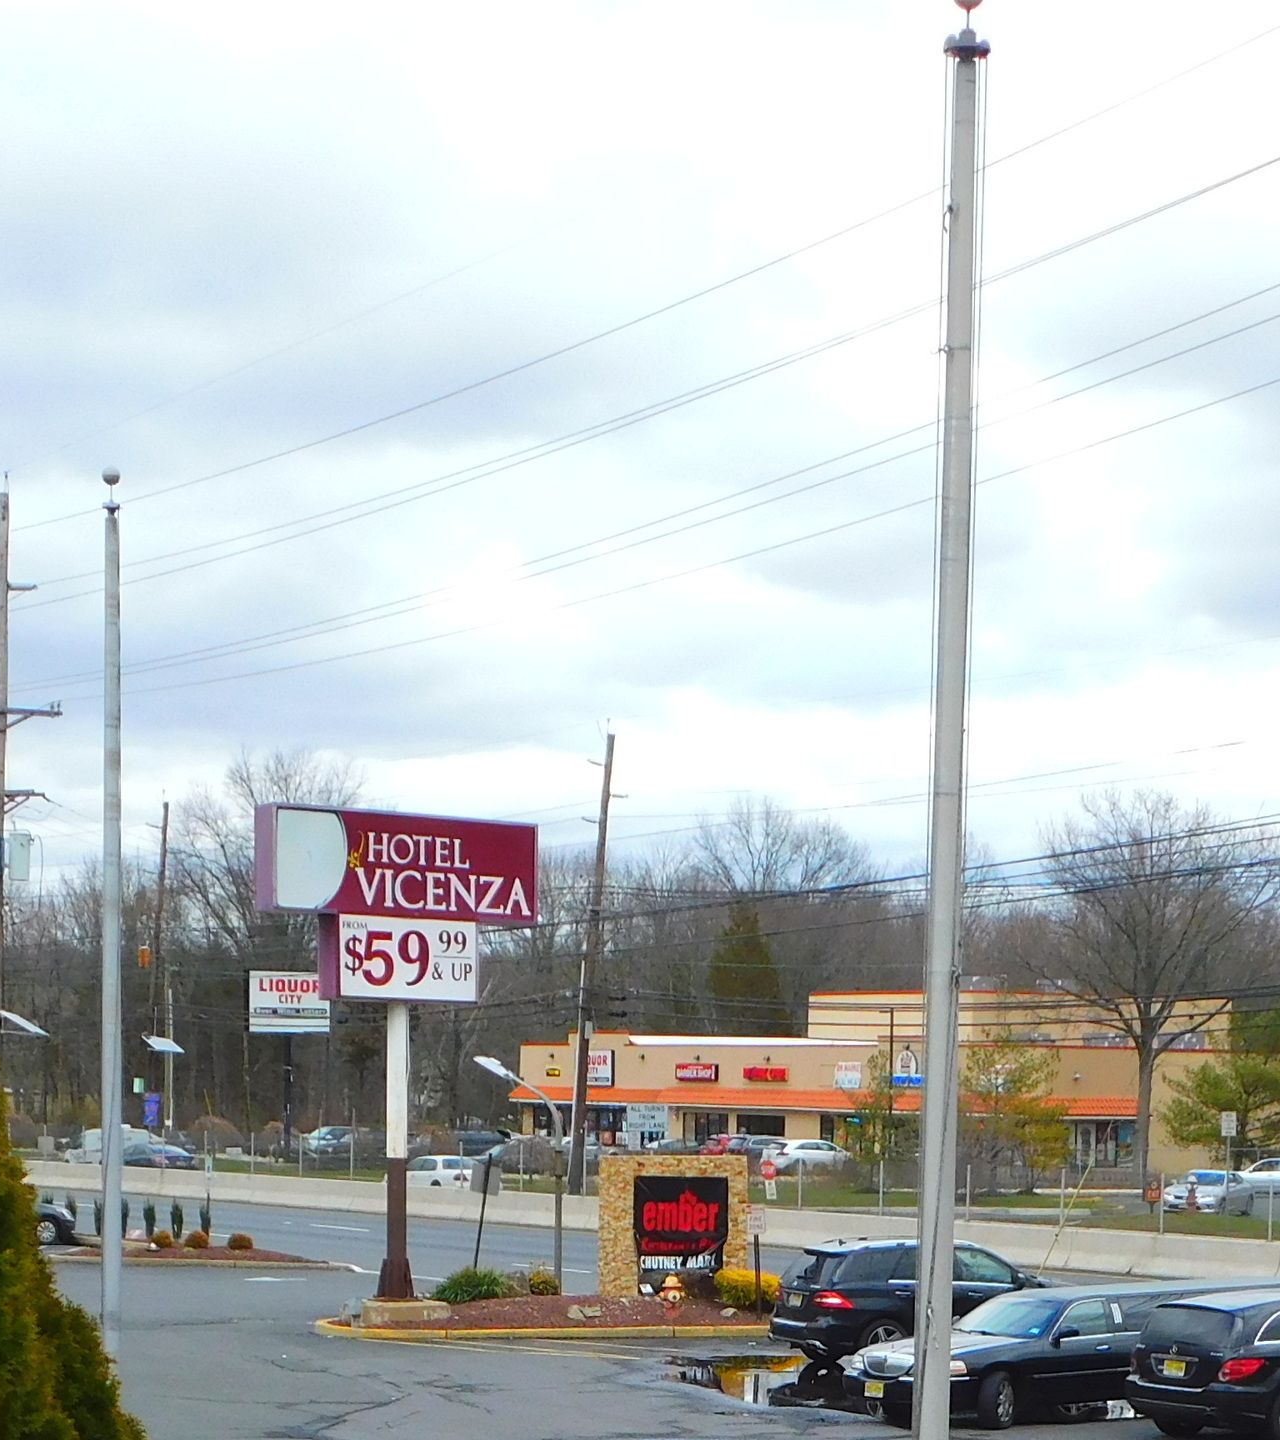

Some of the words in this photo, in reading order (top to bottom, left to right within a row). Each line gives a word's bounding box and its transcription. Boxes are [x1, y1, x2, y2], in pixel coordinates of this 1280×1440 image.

[367, 831, 470, 869] HOTEL
[355, 866, 532, 916] VICENZA
[342, 920, 368, 930] FROM
[438, 929, 467, 954] 99
[431, 961, 443, 981] &
[451, 962, 473, 981] UP
[278, 994, 302, 1004] CITY
[643, 1199, 720, 1232] ember
[640, 1255, 683, 1269] CHUTNEY
